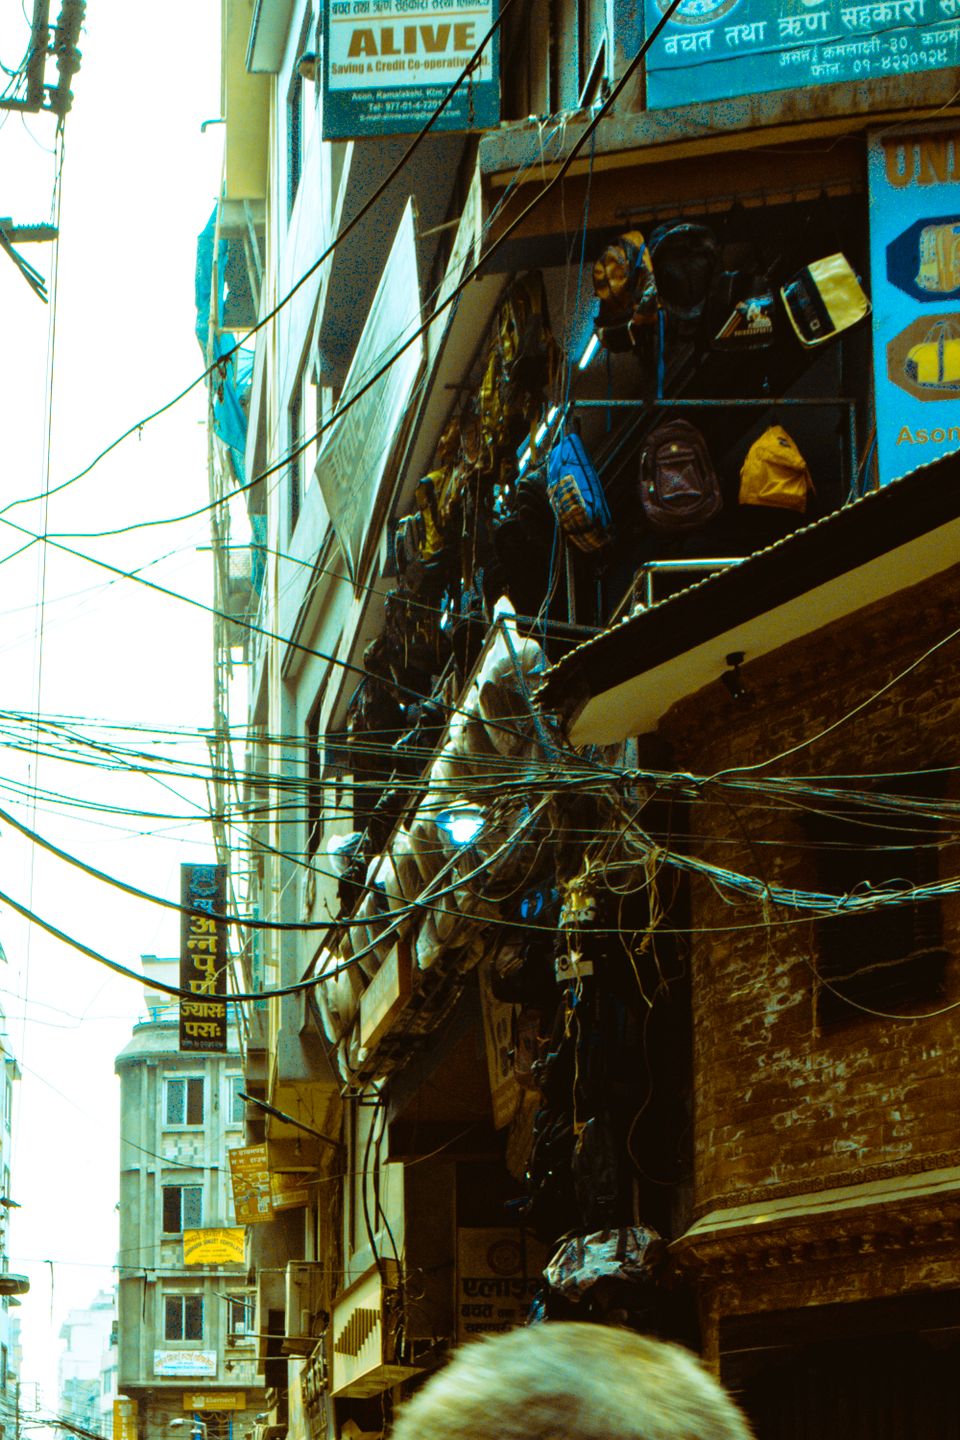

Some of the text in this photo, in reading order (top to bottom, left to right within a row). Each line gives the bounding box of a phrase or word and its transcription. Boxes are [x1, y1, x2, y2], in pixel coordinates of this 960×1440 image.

[348, 22, 476, 57] ALIVE
[664, 29, 715, 54] बचत
[725, 21, 768, 45] तथा
[777, 10, 829, 36] ऋण
[332, 63, 364, 75] Saving
[367, 62, 373, 72] &
[376, 60, 405, 72] Credit
